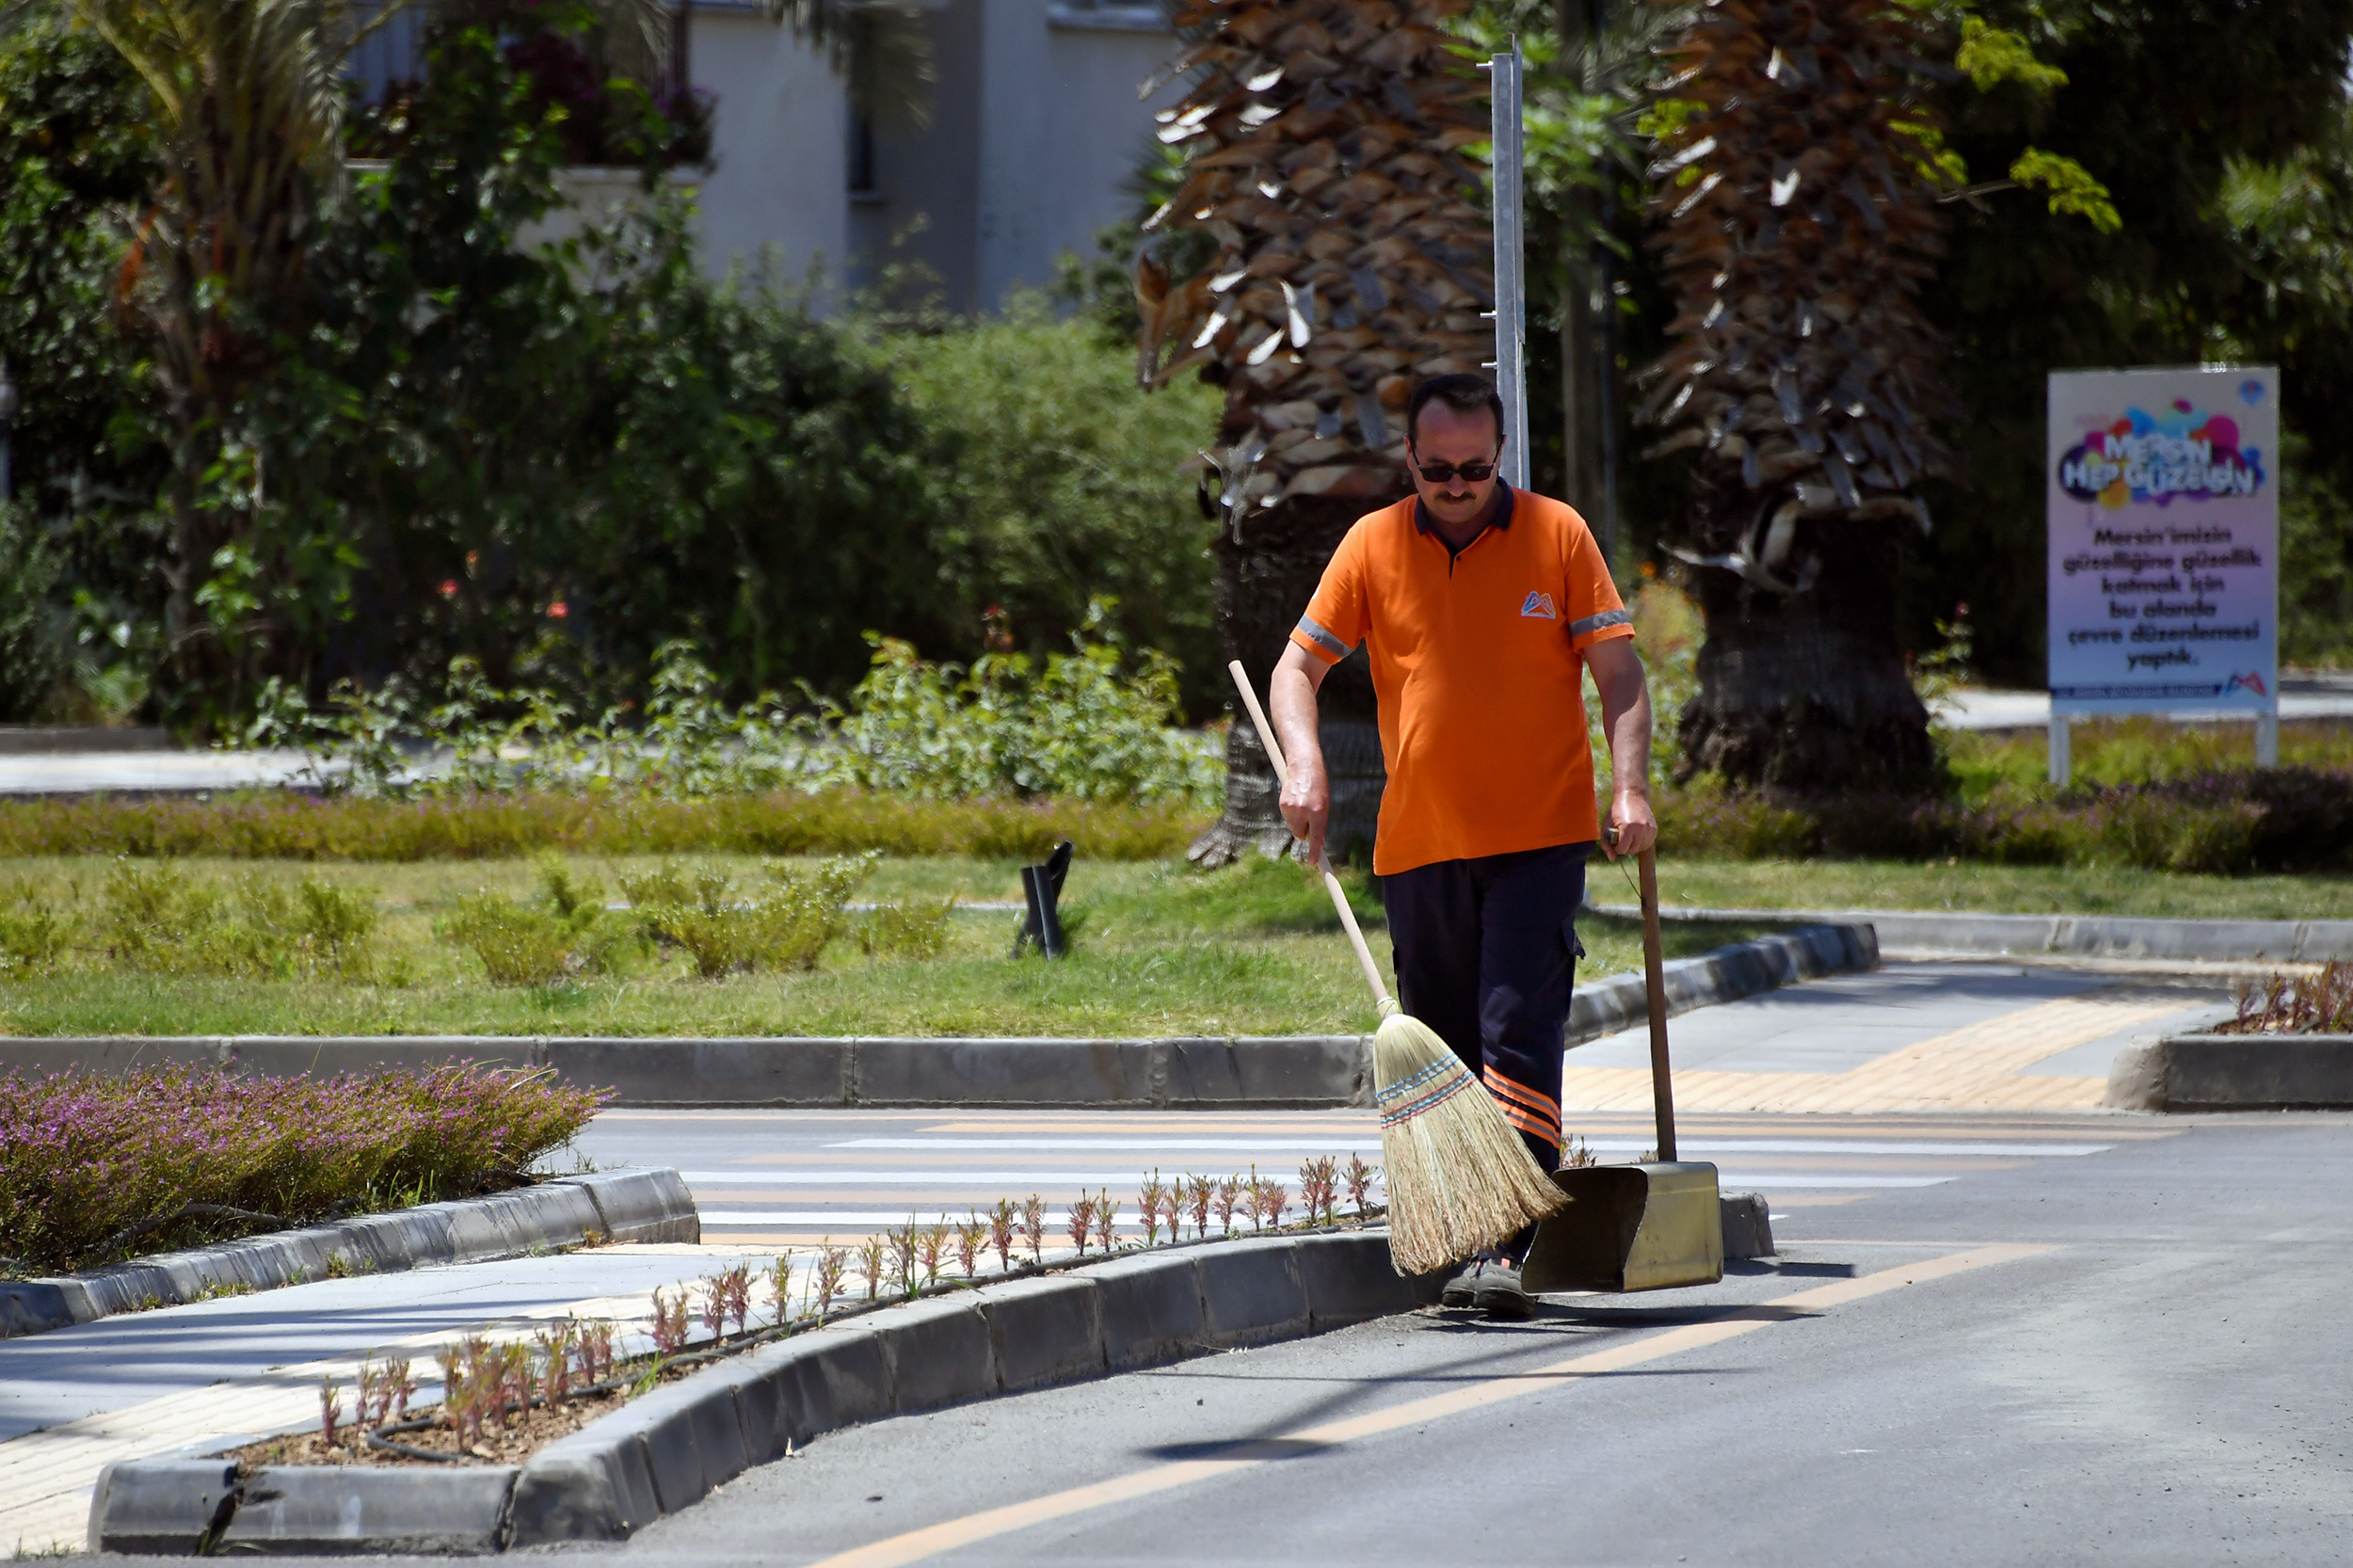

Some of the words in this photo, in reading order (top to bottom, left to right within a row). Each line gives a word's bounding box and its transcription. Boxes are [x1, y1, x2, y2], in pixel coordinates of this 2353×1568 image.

[2063, 460, 2120, 491] HEP
[2182, 546, 2261, 574] güzellik
[2102, 575, 2181, 595] katmak
[2110, 600, 2137, 618] bu
[2143, 598, 2217, 617] alanda
